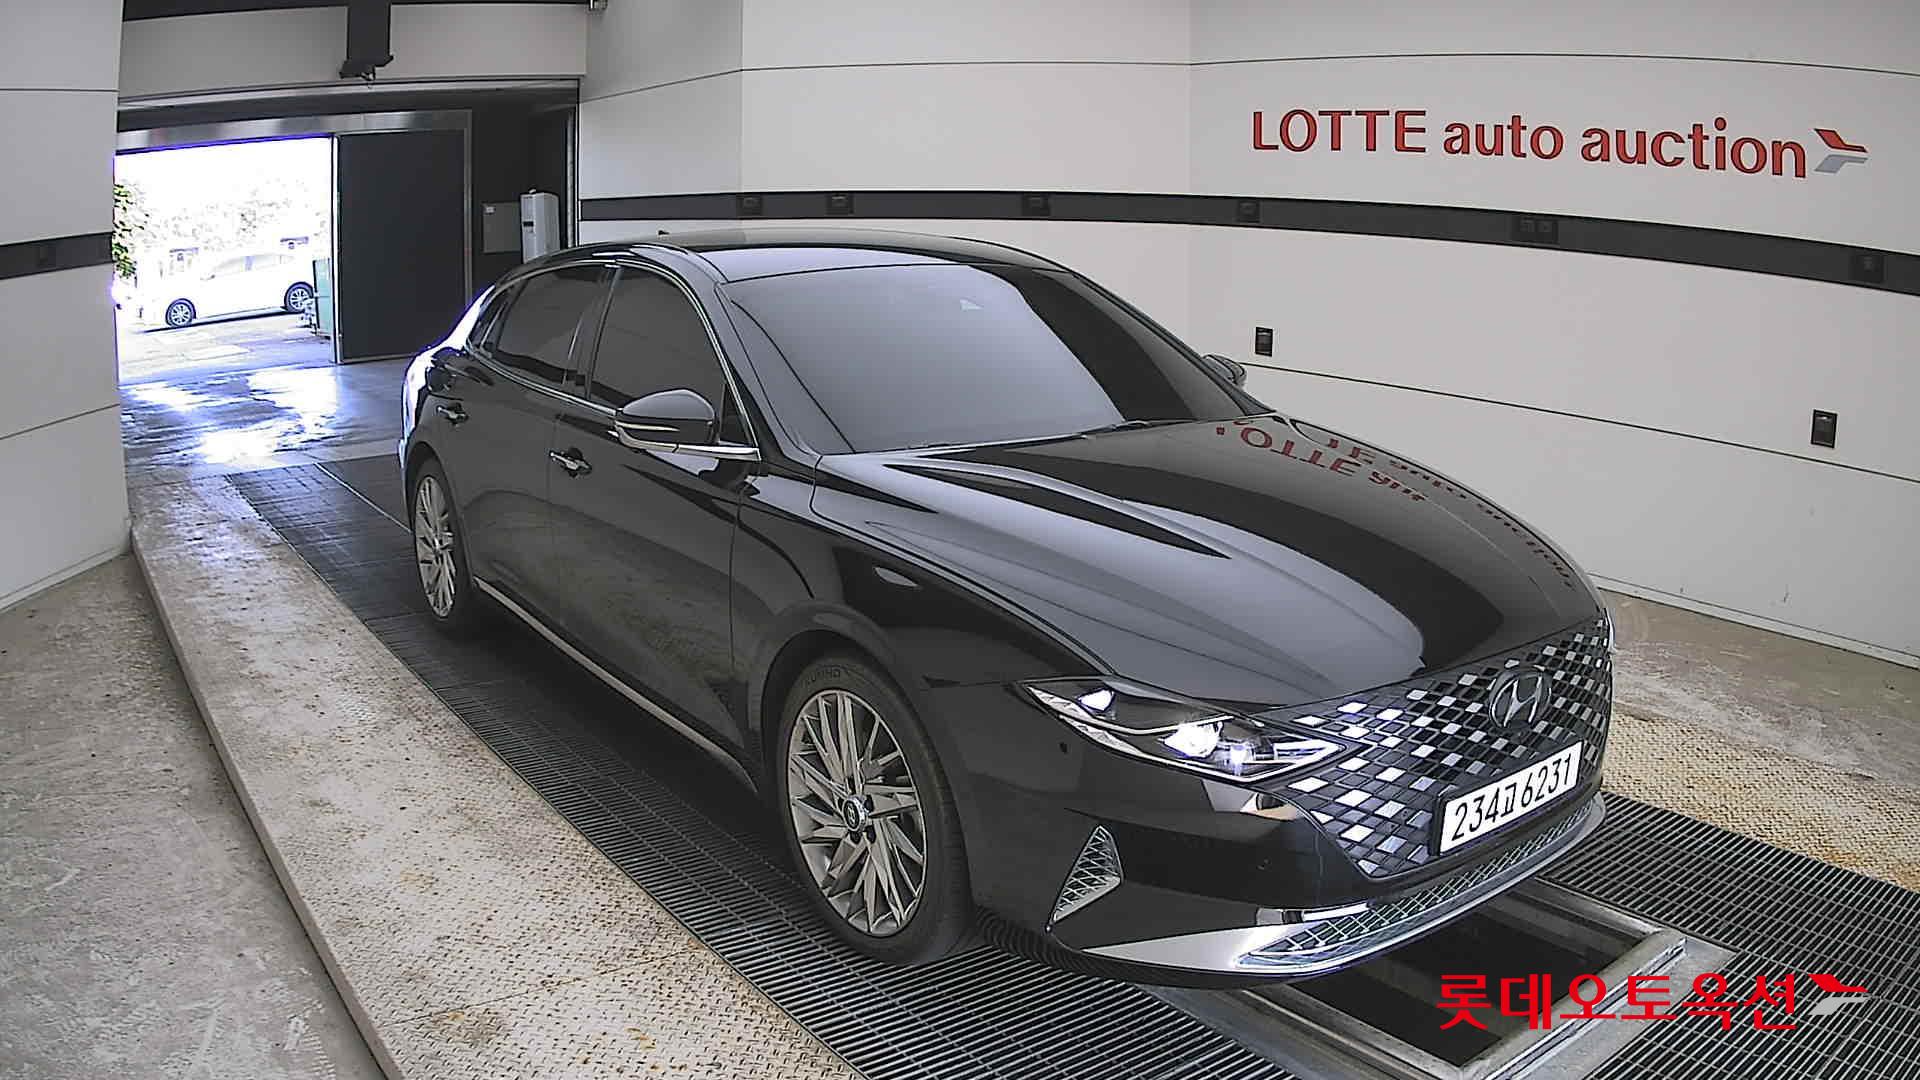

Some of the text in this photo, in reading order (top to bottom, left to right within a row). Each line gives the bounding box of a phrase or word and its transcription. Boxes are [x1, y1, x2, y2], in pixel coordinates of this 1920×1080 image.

[1252, 109, 1807, 179] LOTTE auto auction
[1521, 753, 1572, 808] 6231
